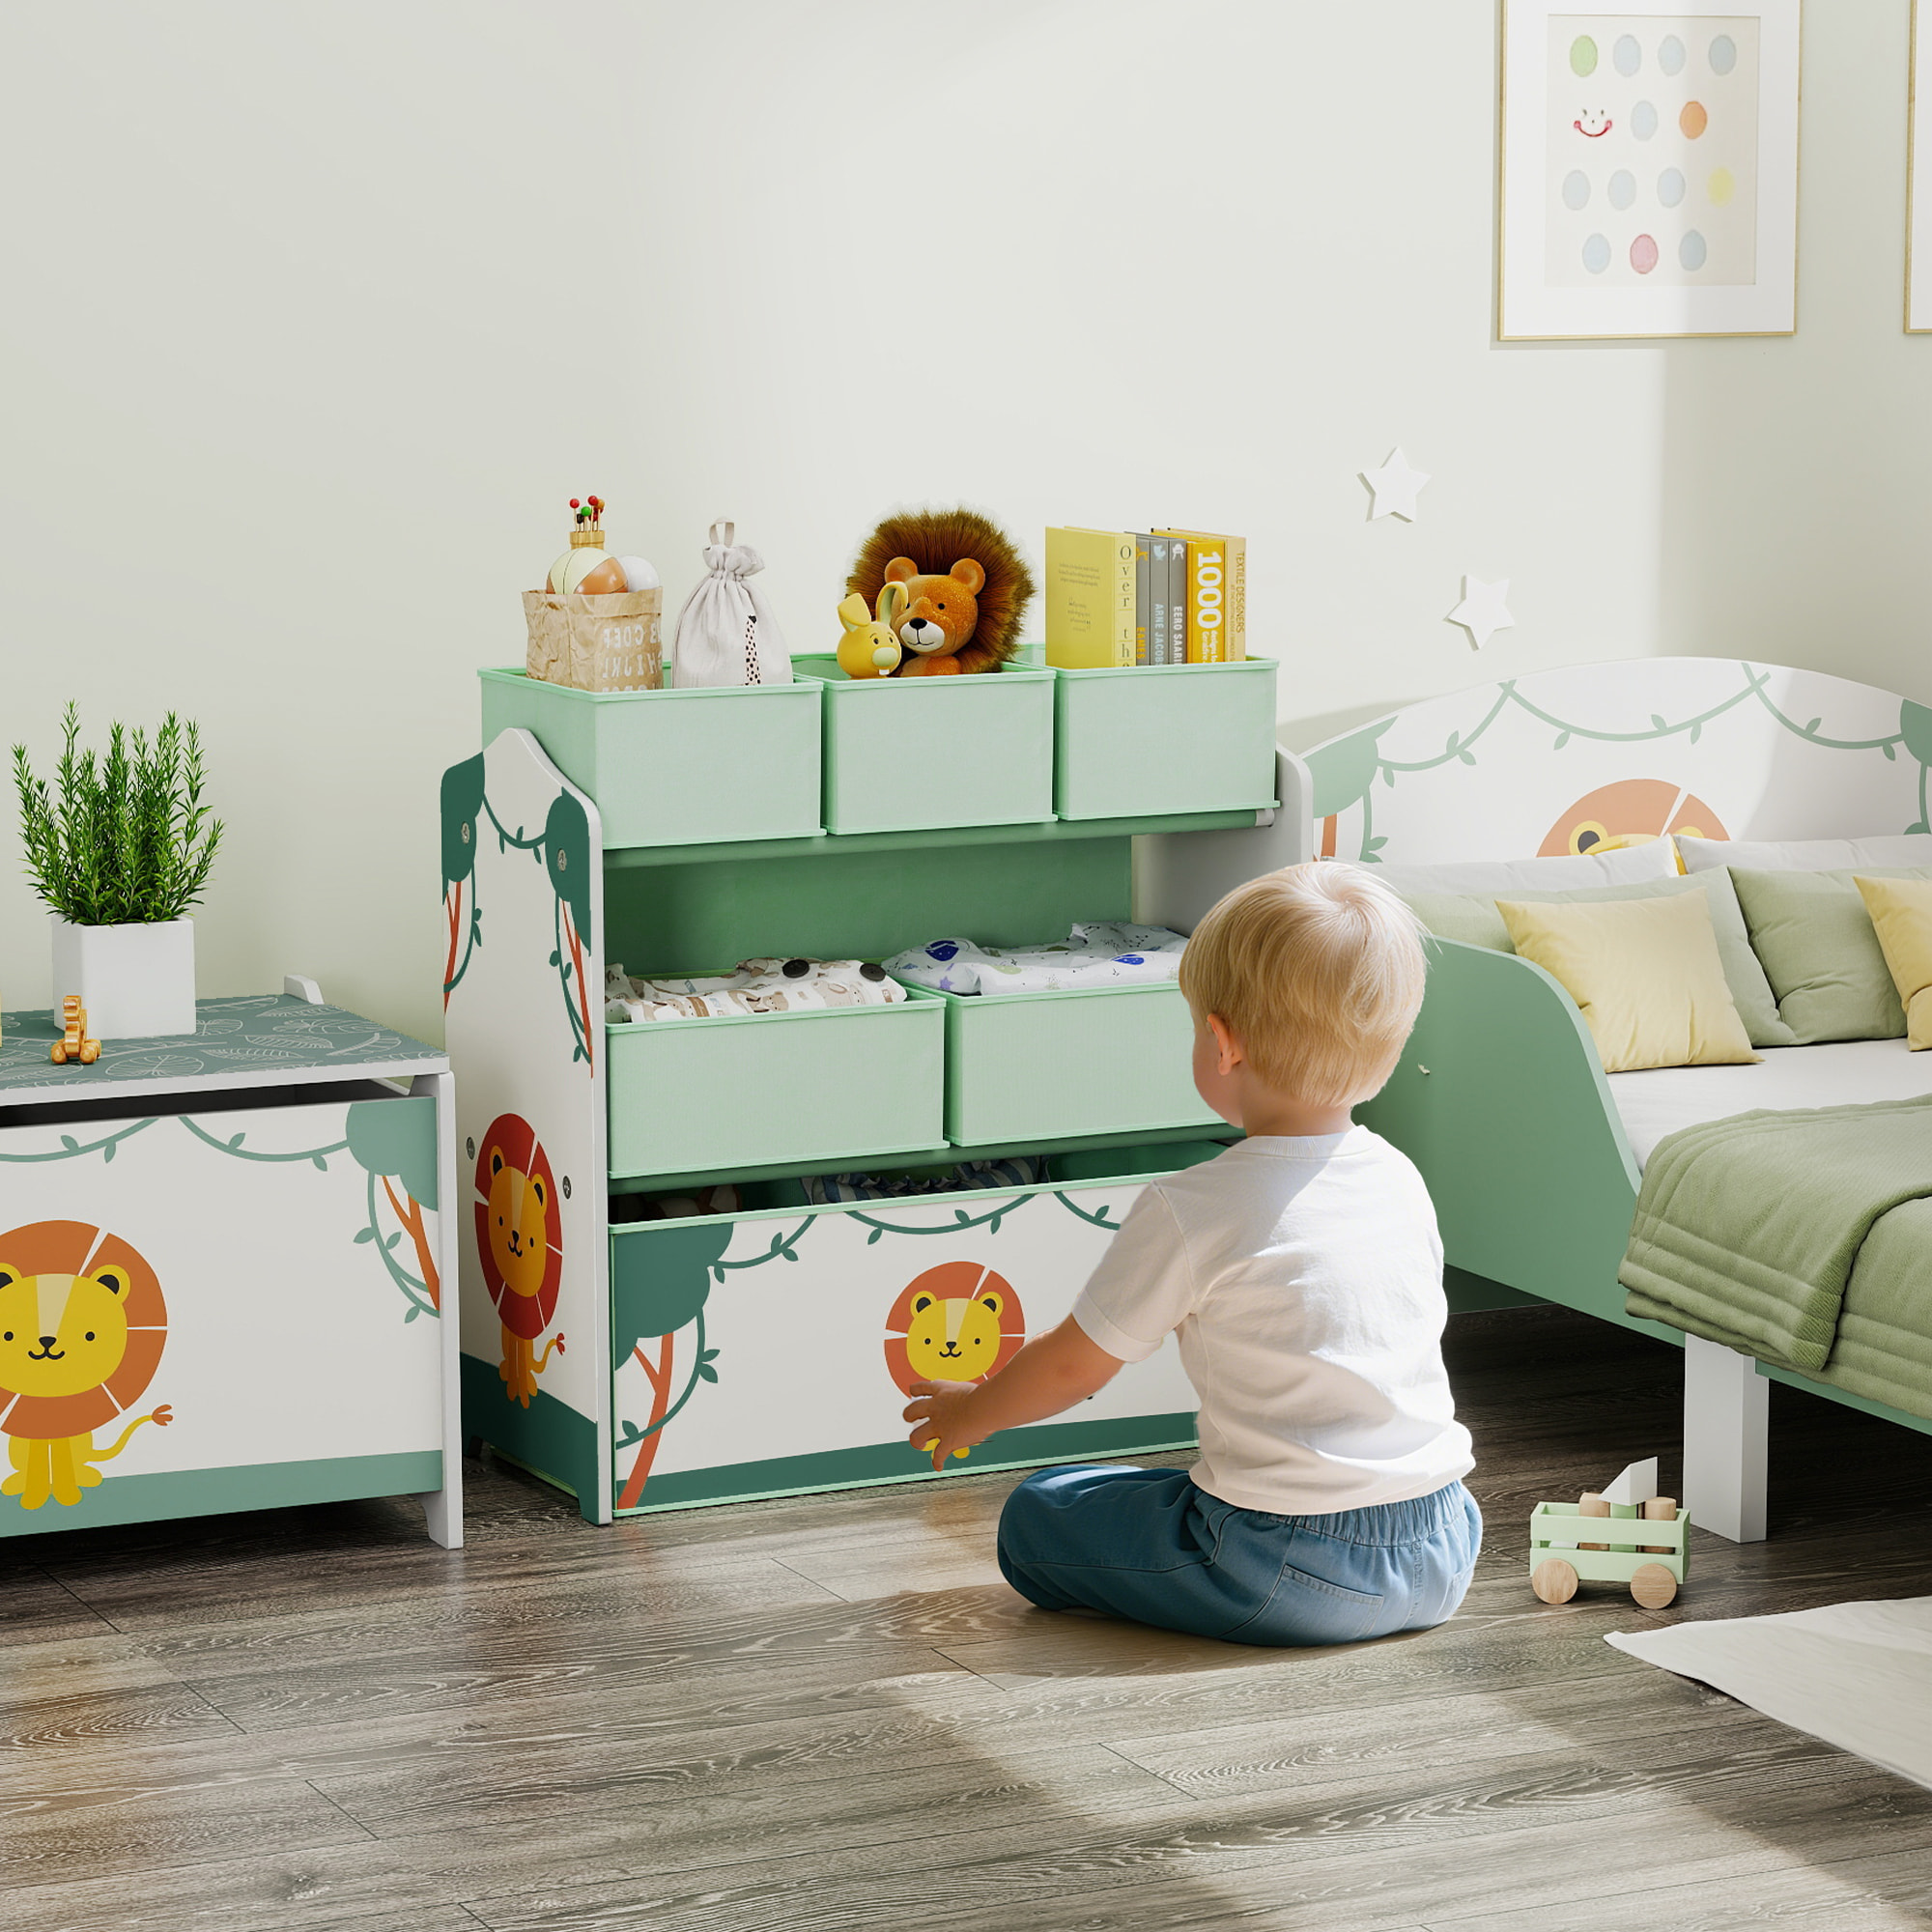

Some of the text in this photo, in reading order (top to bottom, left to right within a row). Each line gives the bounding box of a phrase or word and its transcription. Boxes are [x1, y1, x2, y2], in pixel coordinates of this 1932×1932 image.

[1197, 552, 1222, 629] 1000
[1236, 552, 1244, 634] TEXTILE DESIGNERS
[1154, 604, 1164, 666] ARNE JACOB
[1173, 606, 1183, 666] EERO SAARI
